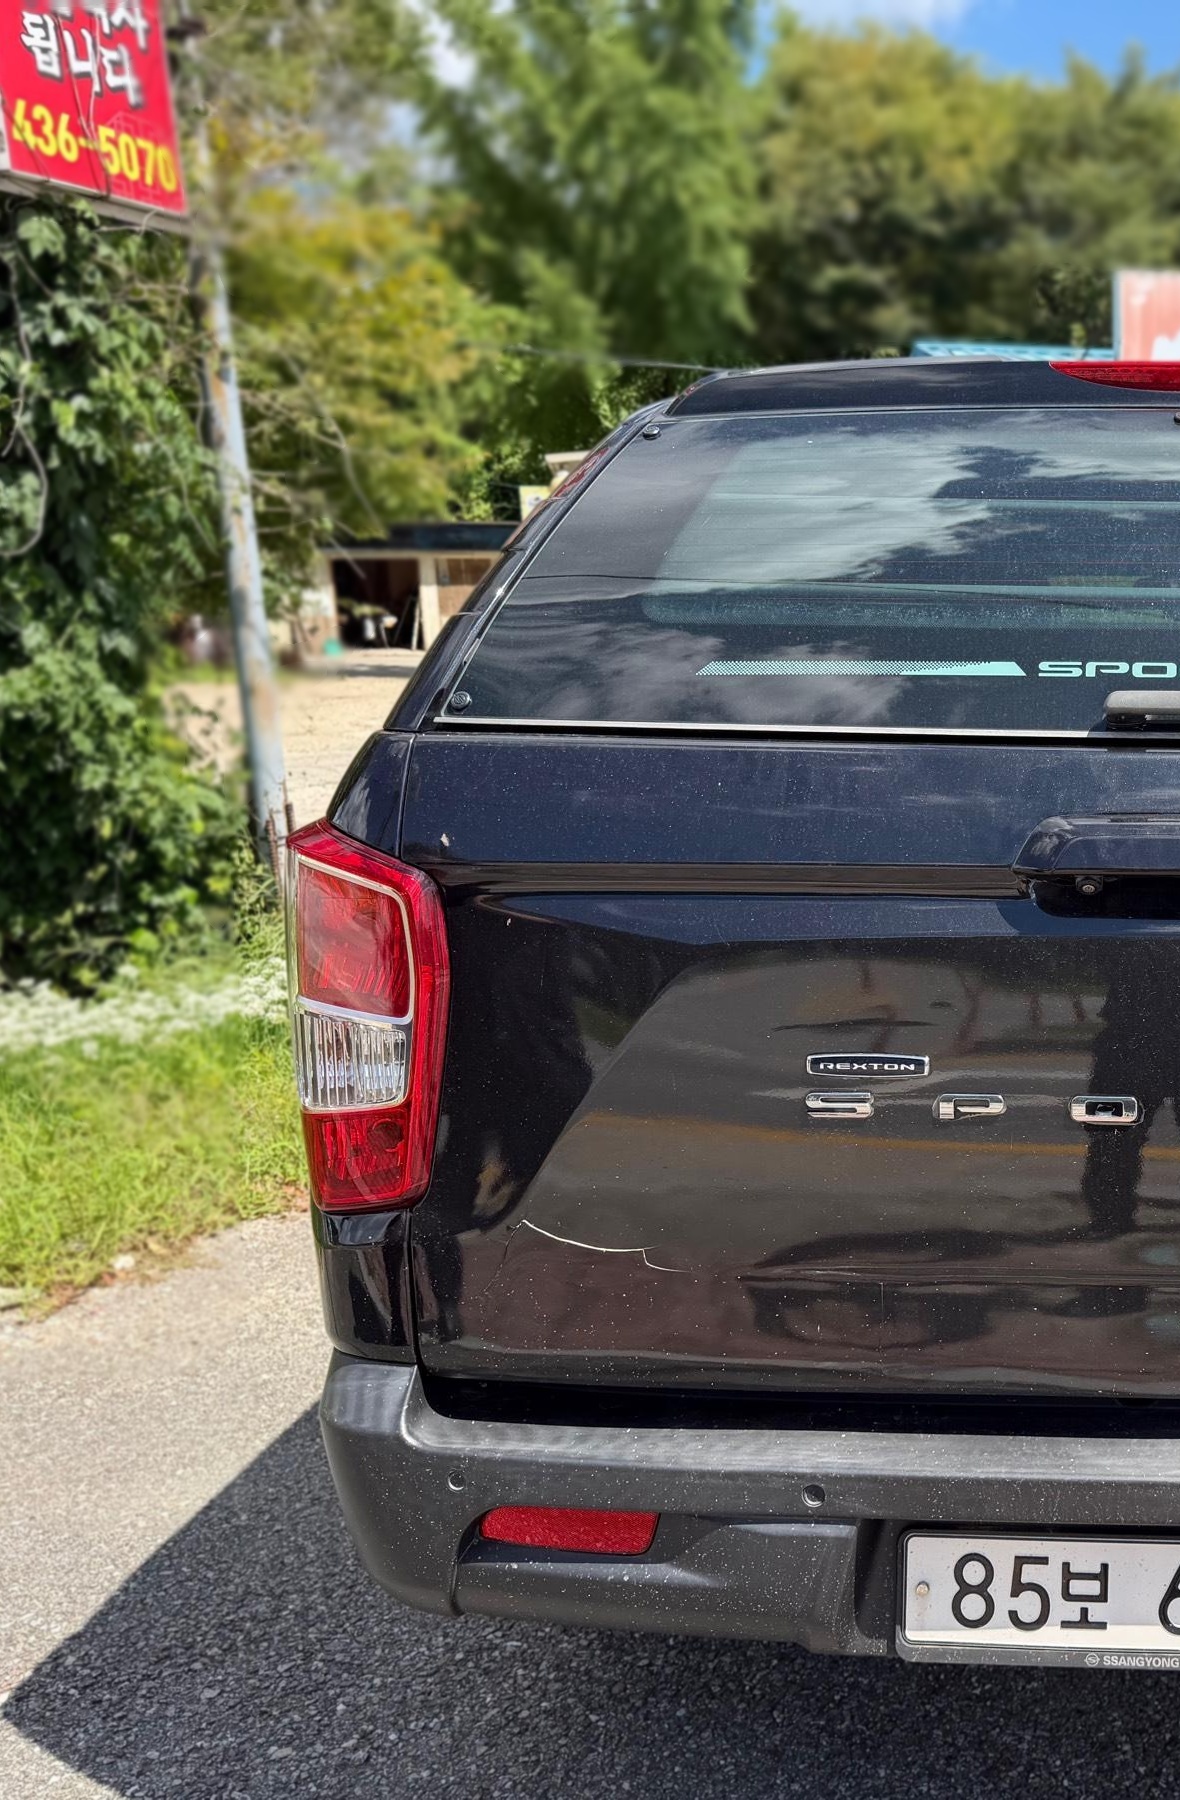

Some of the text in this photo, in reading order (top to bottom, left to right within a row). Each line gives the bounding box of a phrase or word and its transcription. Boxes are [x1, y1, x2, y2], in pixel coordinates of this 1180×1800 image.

[20, 11, 143, 109] 됩니다
[13, 98, 177, 192] 436-5070
[819, 1062, 915, 1071] REXTON
[951, 1552, 1109, 1631] 85보
[1102, 1654, 1180, 1669] SSANGYONG
